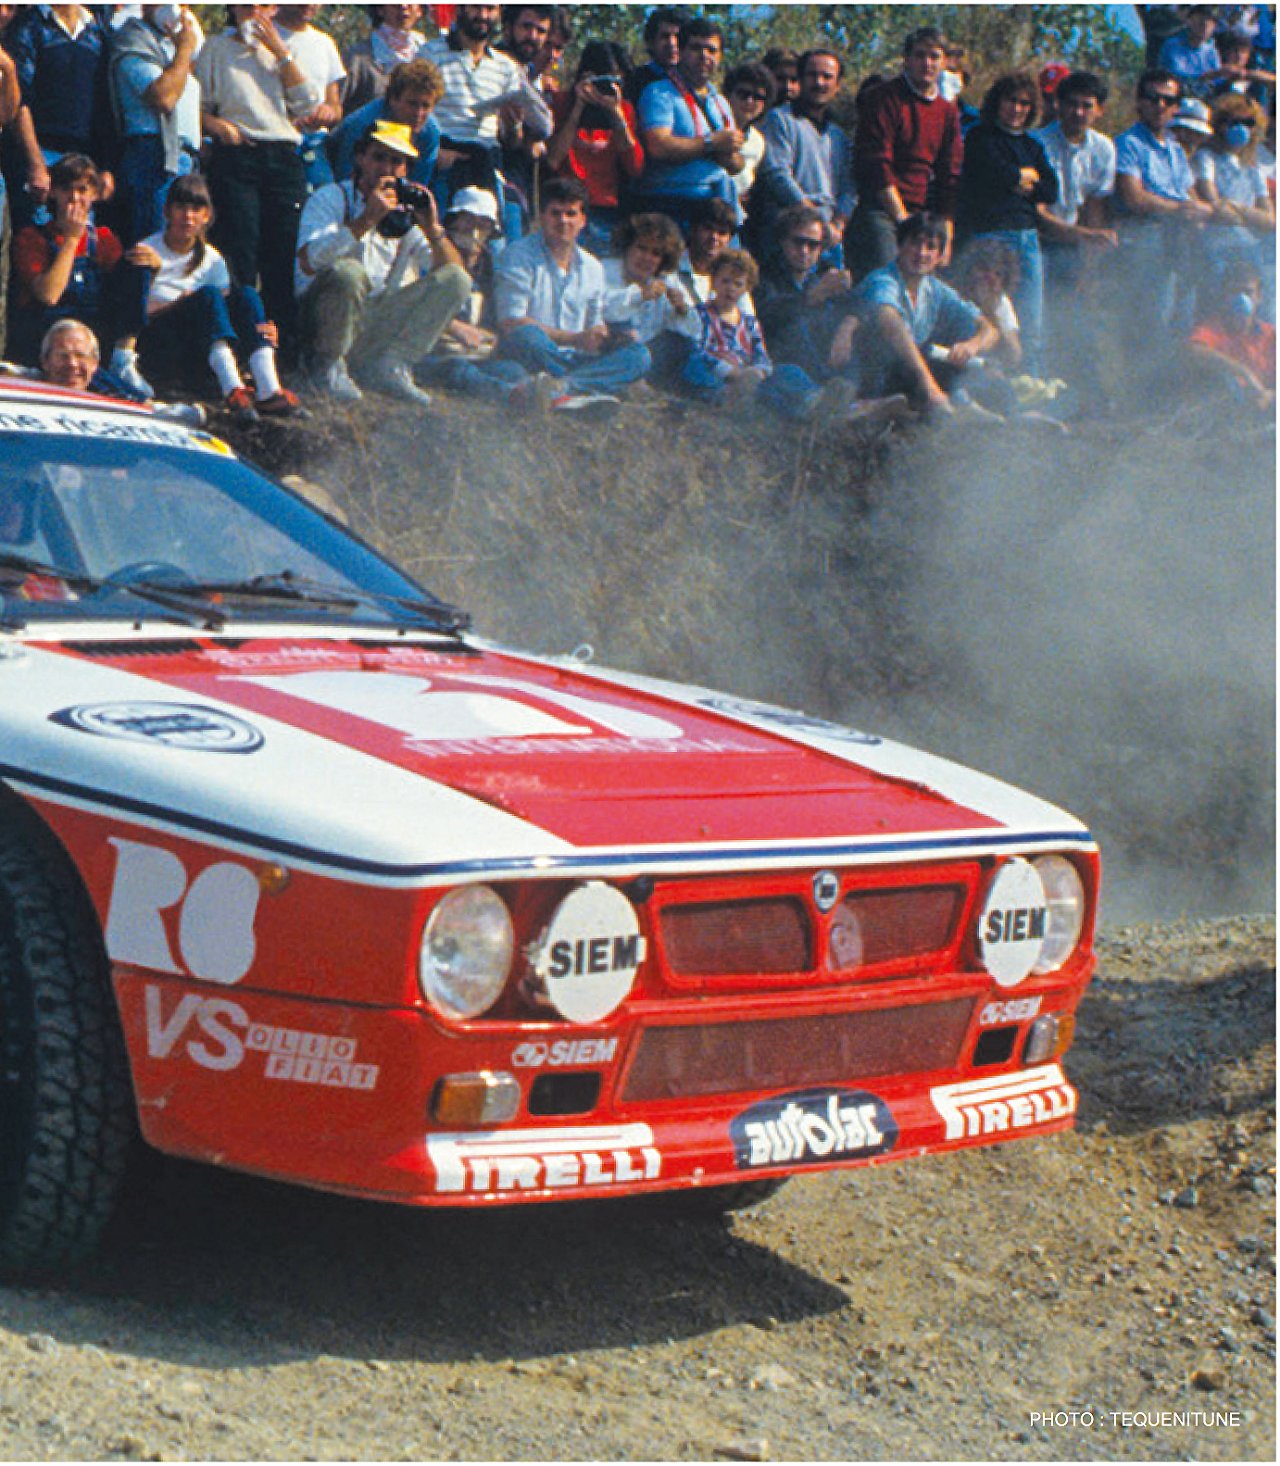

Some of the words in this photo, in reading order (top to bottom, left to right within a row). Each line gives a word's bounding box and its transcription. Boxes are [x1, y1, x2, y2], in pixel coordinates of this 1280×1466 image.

[984, 907, 1047, 944] SIEM
[548, 934, 640, 979] SIEM
[145, 985, 249, 1071] VS
[248, 1024, 356, 1060] OLIO
[268, 1056, 377, 1087] FIAT
[549, 1038, 618, 1065] SIEM
[930, 1062, 1079, 1141] PIRELLI
[426, 1122, 662, 1193] PIRELLI
